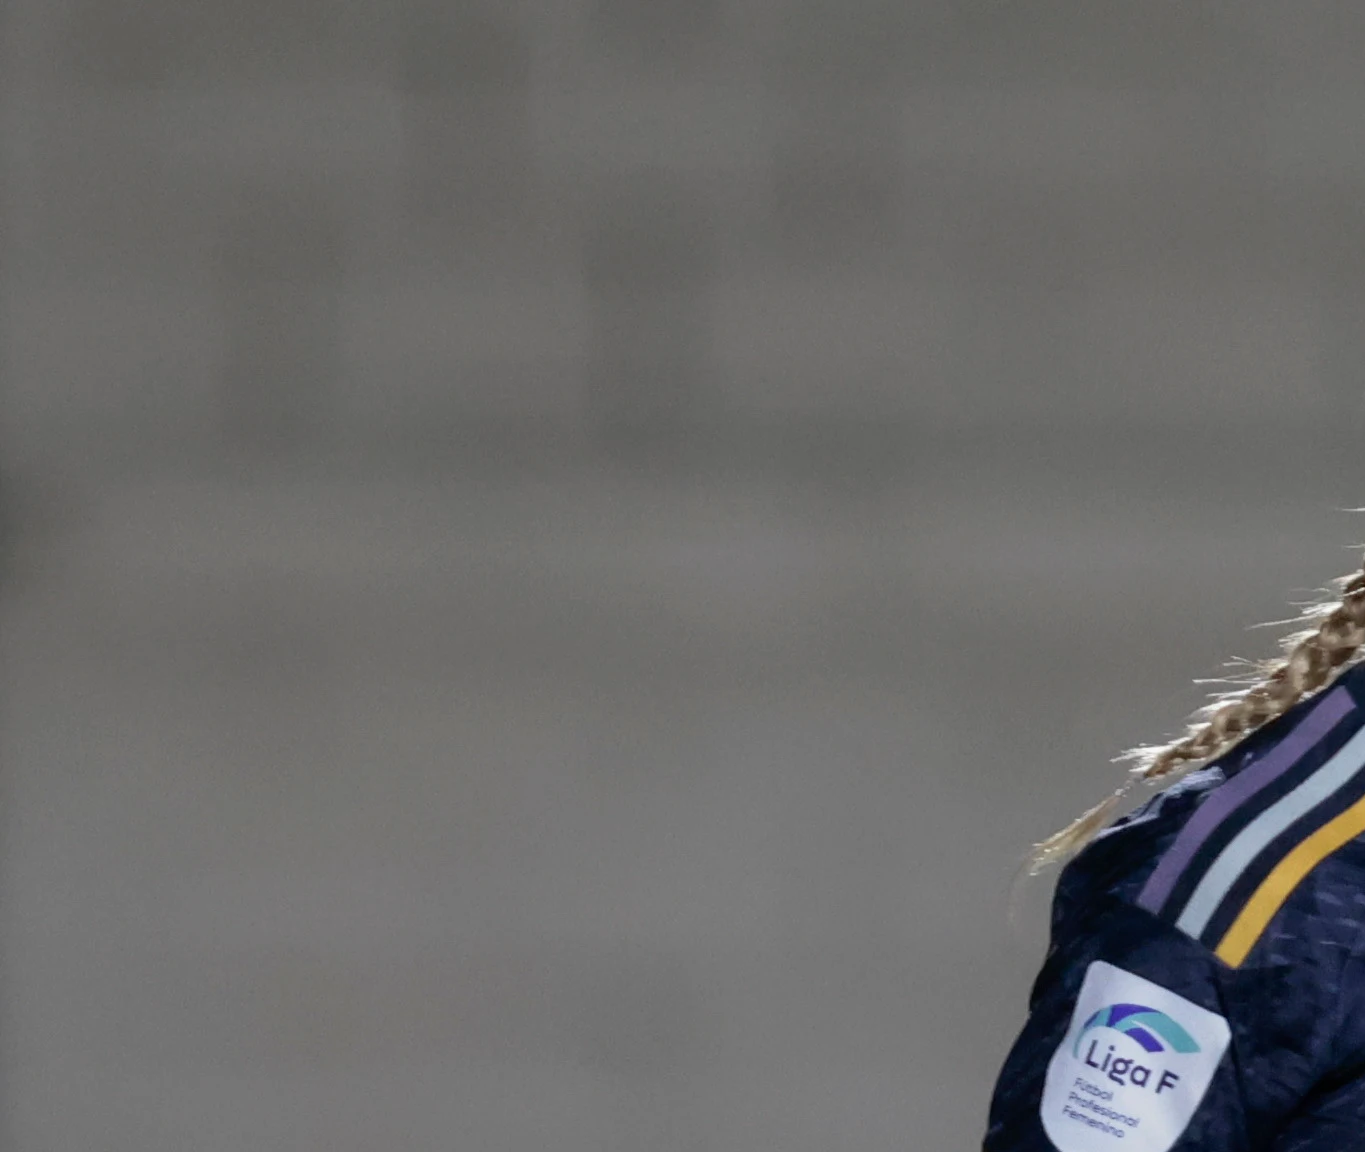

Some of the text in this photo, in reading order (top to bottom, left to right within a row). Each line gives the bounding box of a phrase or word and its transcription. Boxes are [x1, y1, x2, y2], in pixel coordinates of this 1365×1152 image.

[1085, 1039, 1180, 1094] Liga F
[1063, 1105, 1124, 1138] Femenino
[1068, 1091, 1140, 1127] Profesional
